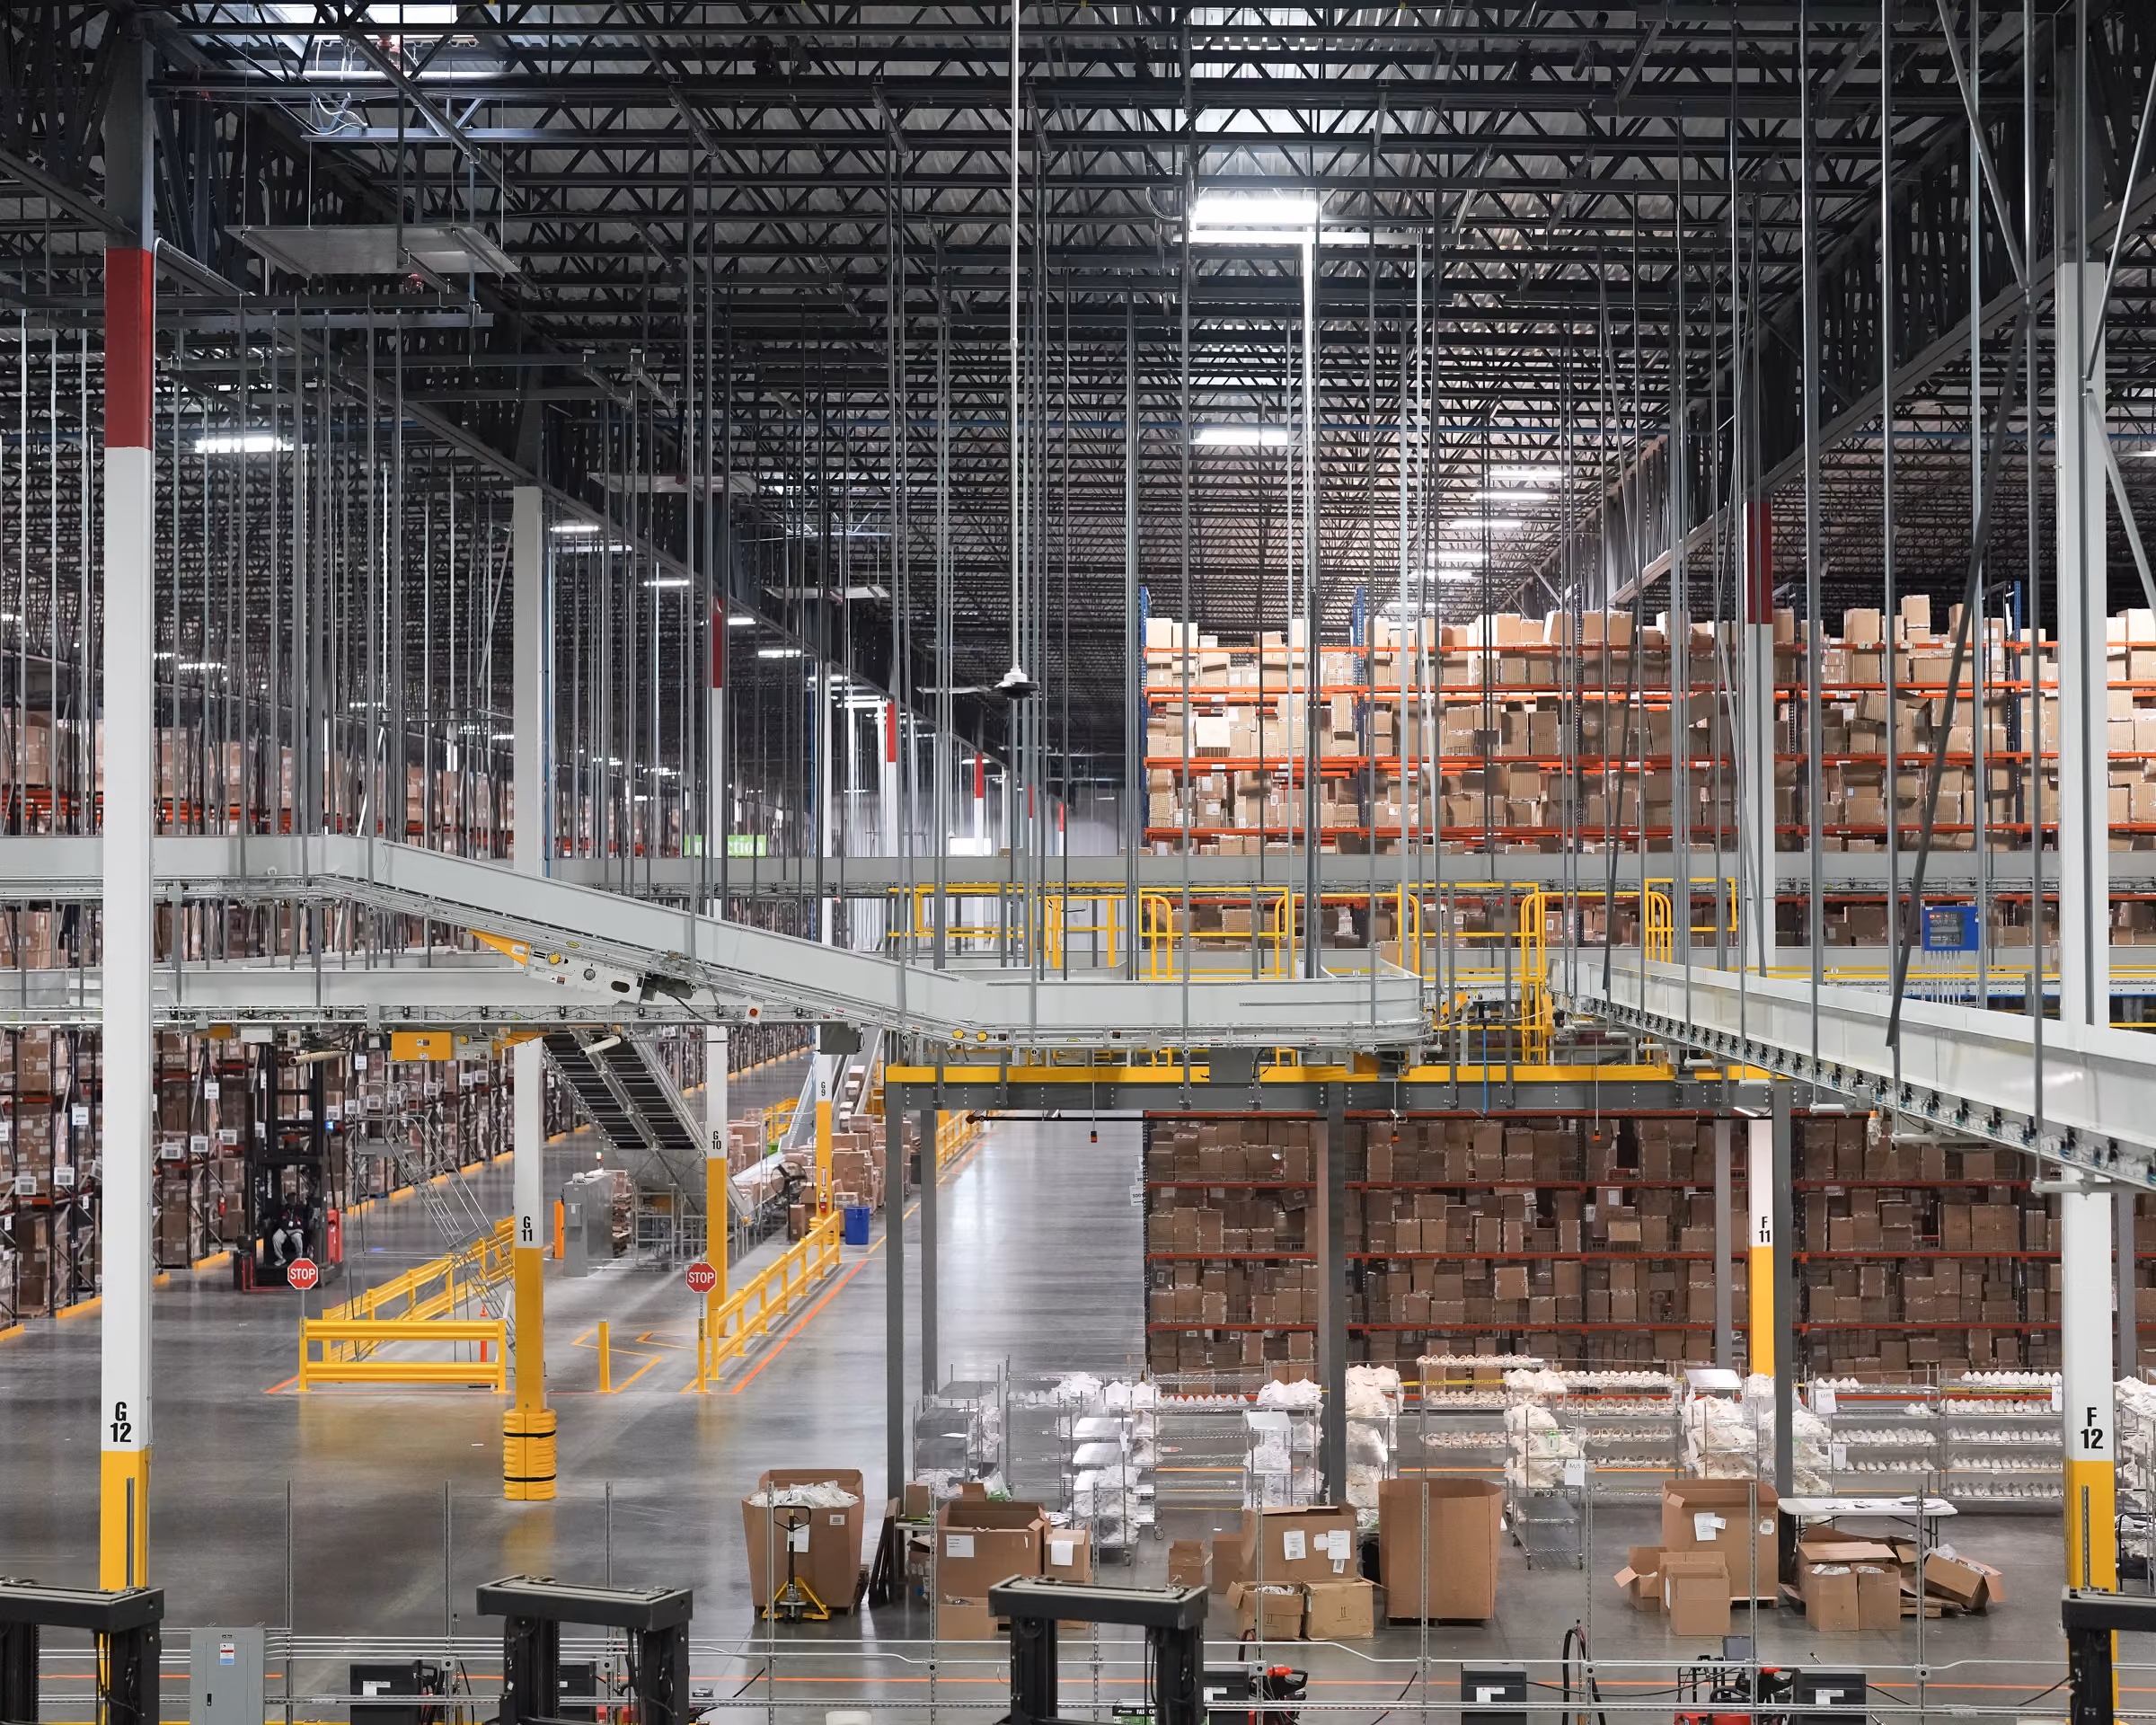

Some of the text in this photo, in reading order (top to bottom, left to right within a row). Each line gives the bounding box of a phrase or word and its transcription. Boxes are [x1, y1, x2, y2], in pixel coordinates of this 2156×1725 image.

[821, 1088, 826, 1096] 9
[712, 1130, 719, 1140] G
[711, 1140, 721, 1150] 10
[523, 1216, 531, 1229] G
[1762, 1216, 1768, 1228] F
[521, 1229, 533, 1242] 11
[1759, 1230, 1771, 1243] 11
[290, 1268, 316, 1280] STOP
[688, 1271, 715, 1284] STOP
[115, 1401, 127, 1421] G
[2087, 1407, 2098, 1427] F
[110, 1422, 132, 1443] 12
[2081, 1428, 2104, 1449] 12
